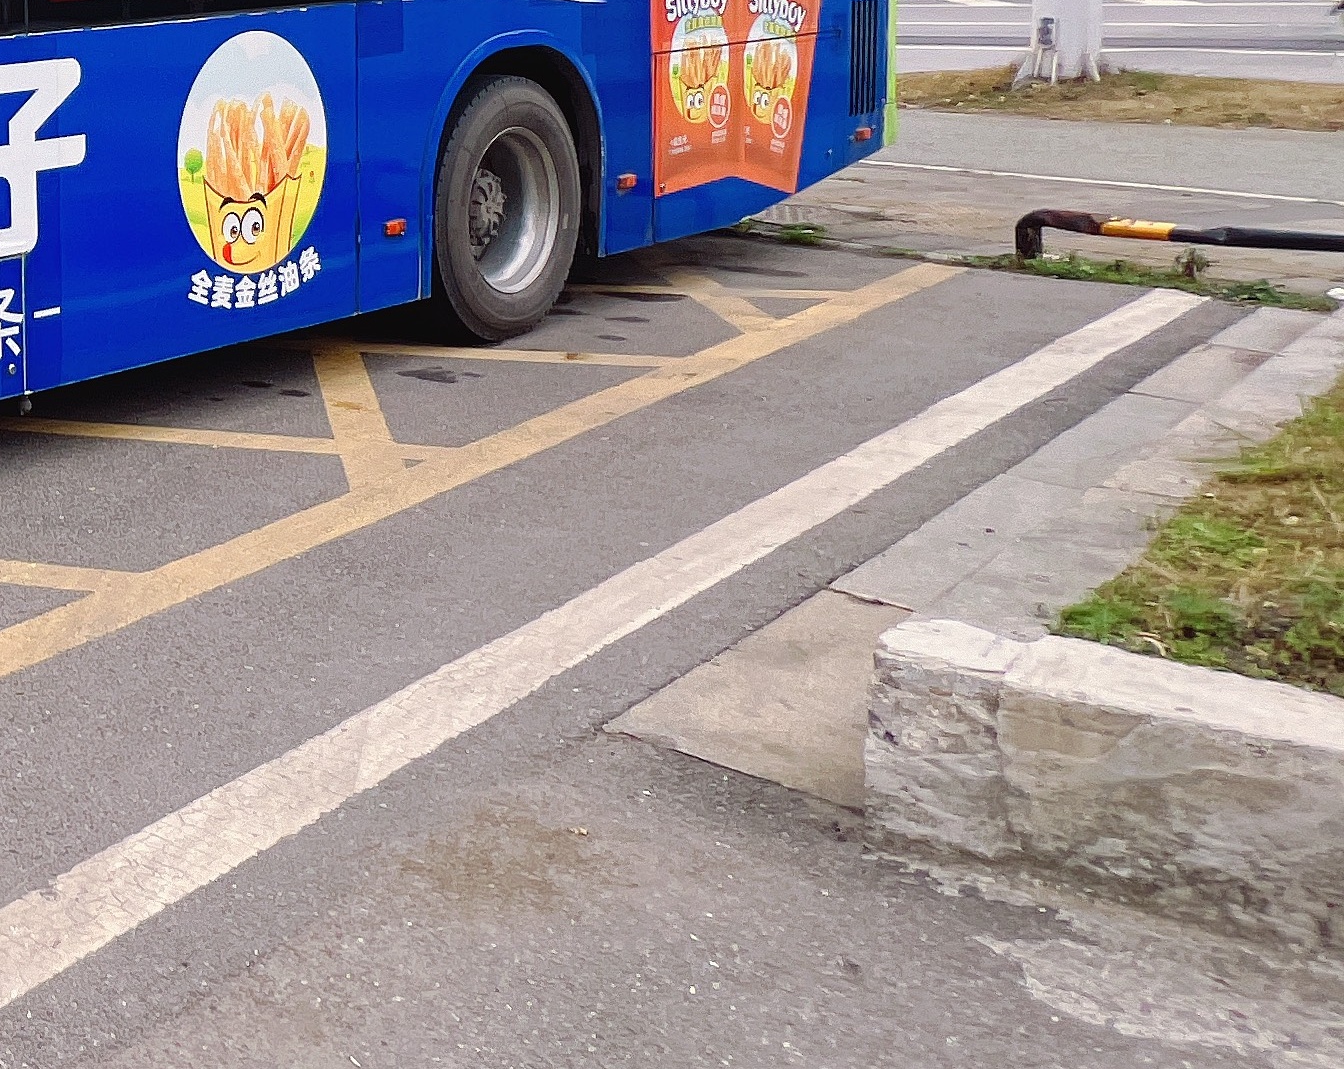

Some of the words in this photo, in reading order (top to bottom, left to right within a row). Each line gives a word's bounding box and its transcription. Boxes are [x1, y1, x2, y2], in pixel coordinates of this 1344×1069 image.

[188, 245, 321, 310] 全麦金丝油条
